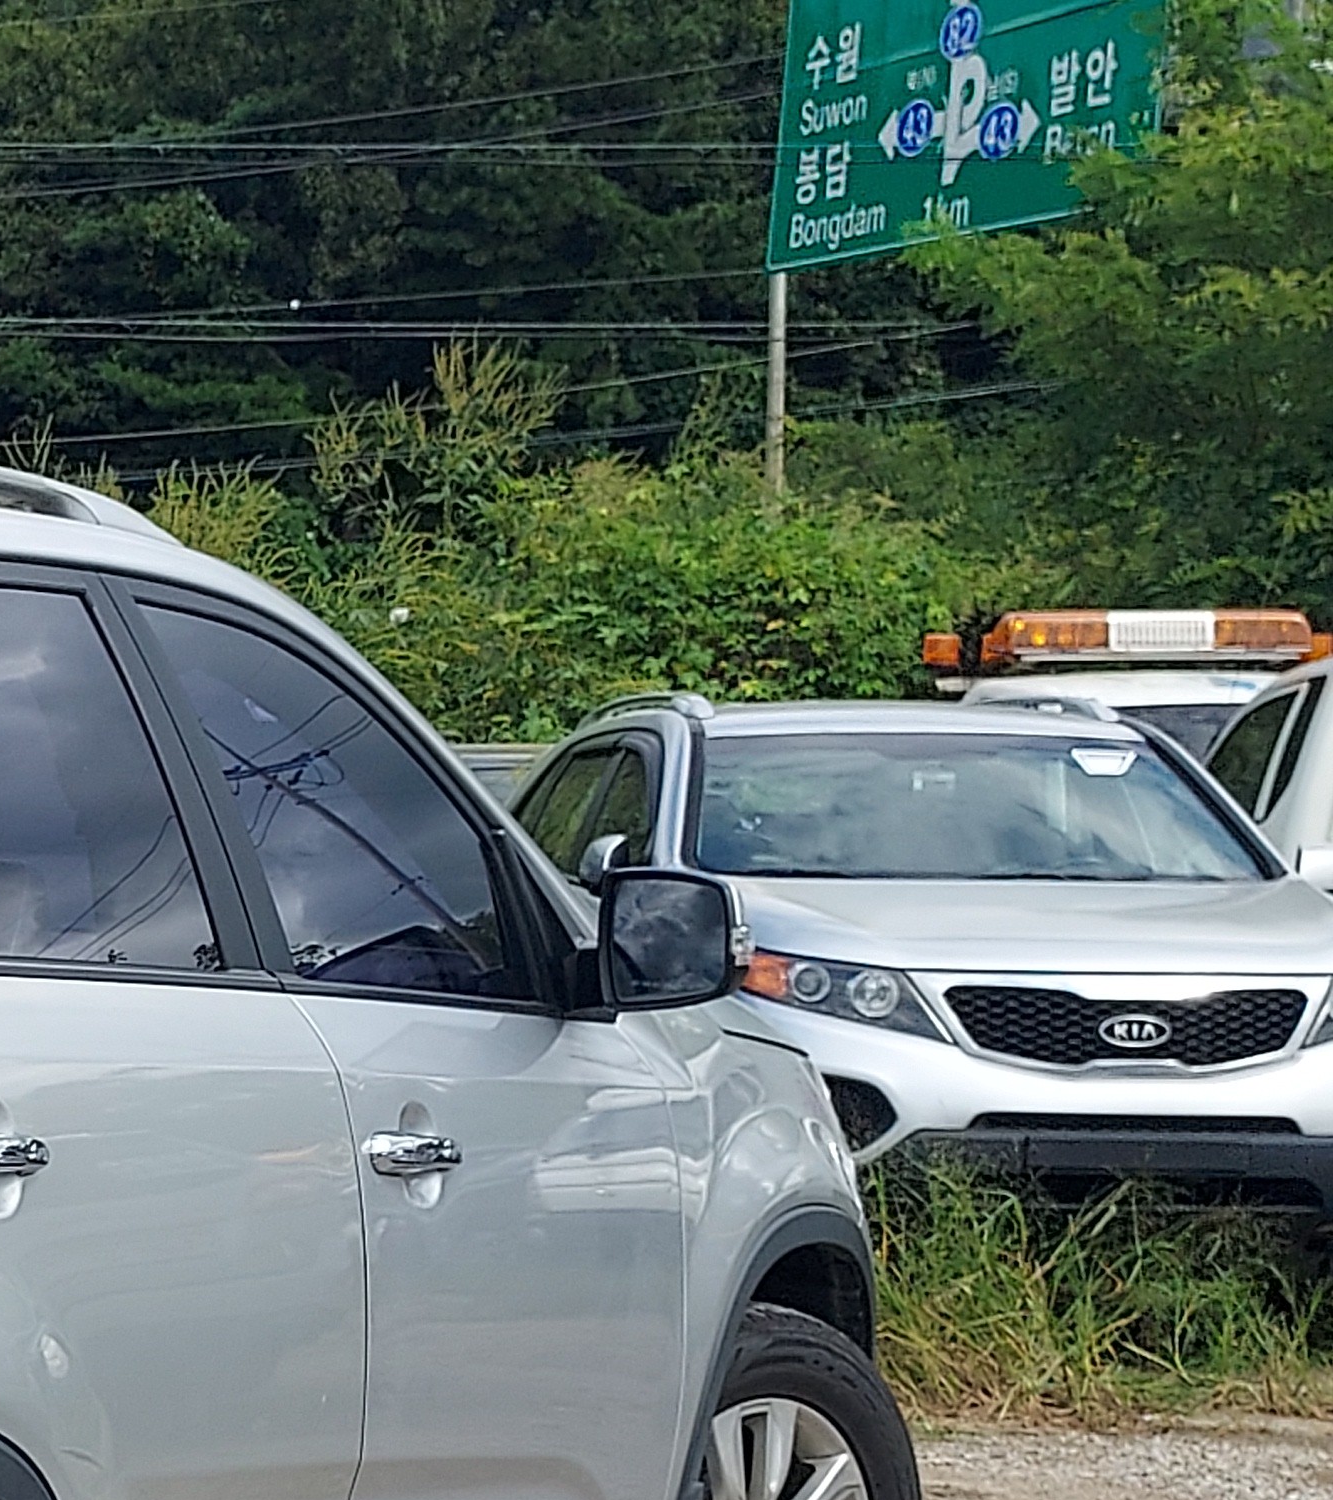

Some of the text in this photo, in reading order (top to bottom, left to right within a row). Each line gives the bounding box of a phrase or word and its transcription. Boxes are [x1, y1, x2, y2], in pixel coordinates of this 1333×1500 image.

[946, 11, 978, 55] 82
[805, 21, 862, 91] 수원
[1051, 38, 1119, 117] 발안
[799, 94, 868, 136] Suwon
[902, 107, 930, 147] 43
[984, 110, 1014, 153] 43
[795, 140, 852, 205] 봉담
[789, 201, 887, 251] Bongdam
[1113, 1022, 1157, 1040] KIA
